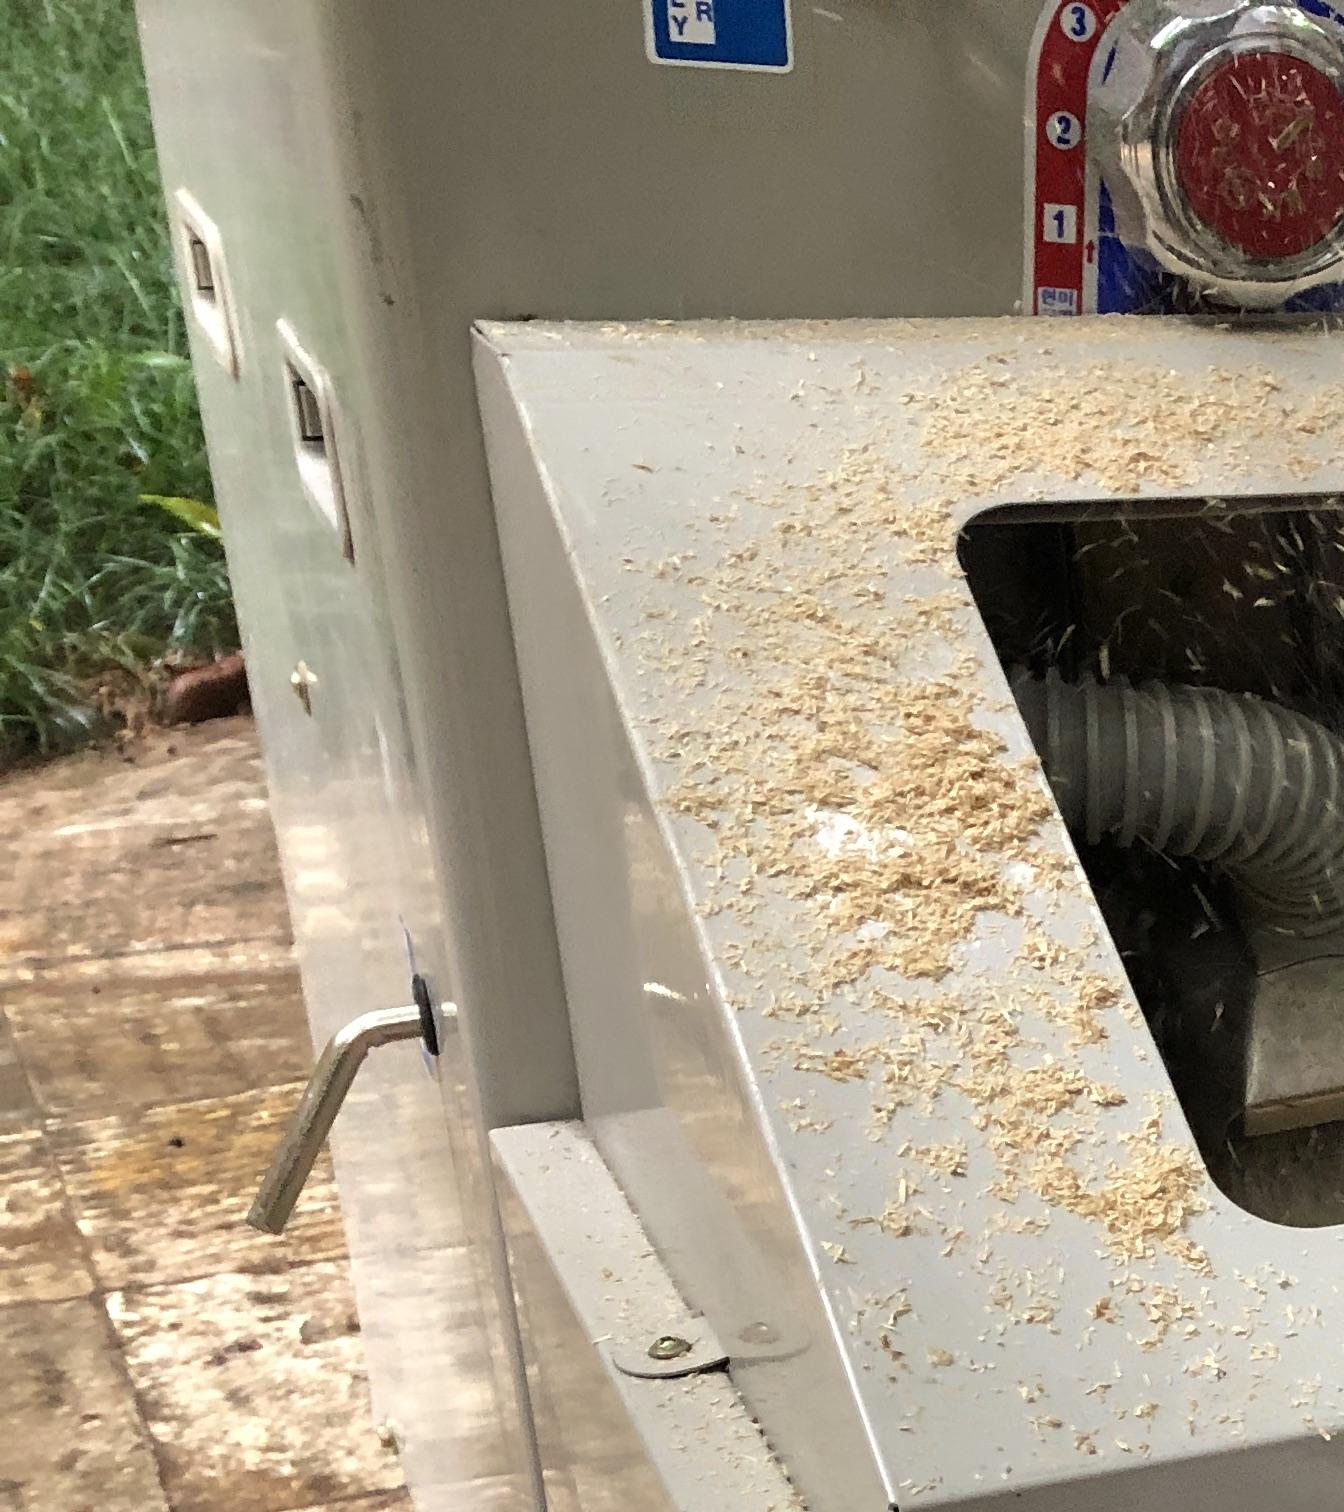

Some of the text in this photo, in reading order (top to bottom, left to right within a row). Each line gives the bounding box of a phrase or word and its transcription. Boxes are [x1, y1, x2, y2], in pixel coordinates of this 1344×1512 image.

[1070, 6, 1087, 36] 3
[1055, 115, 1072, 145] 2
[1053, 209, 1065, 238] 1
